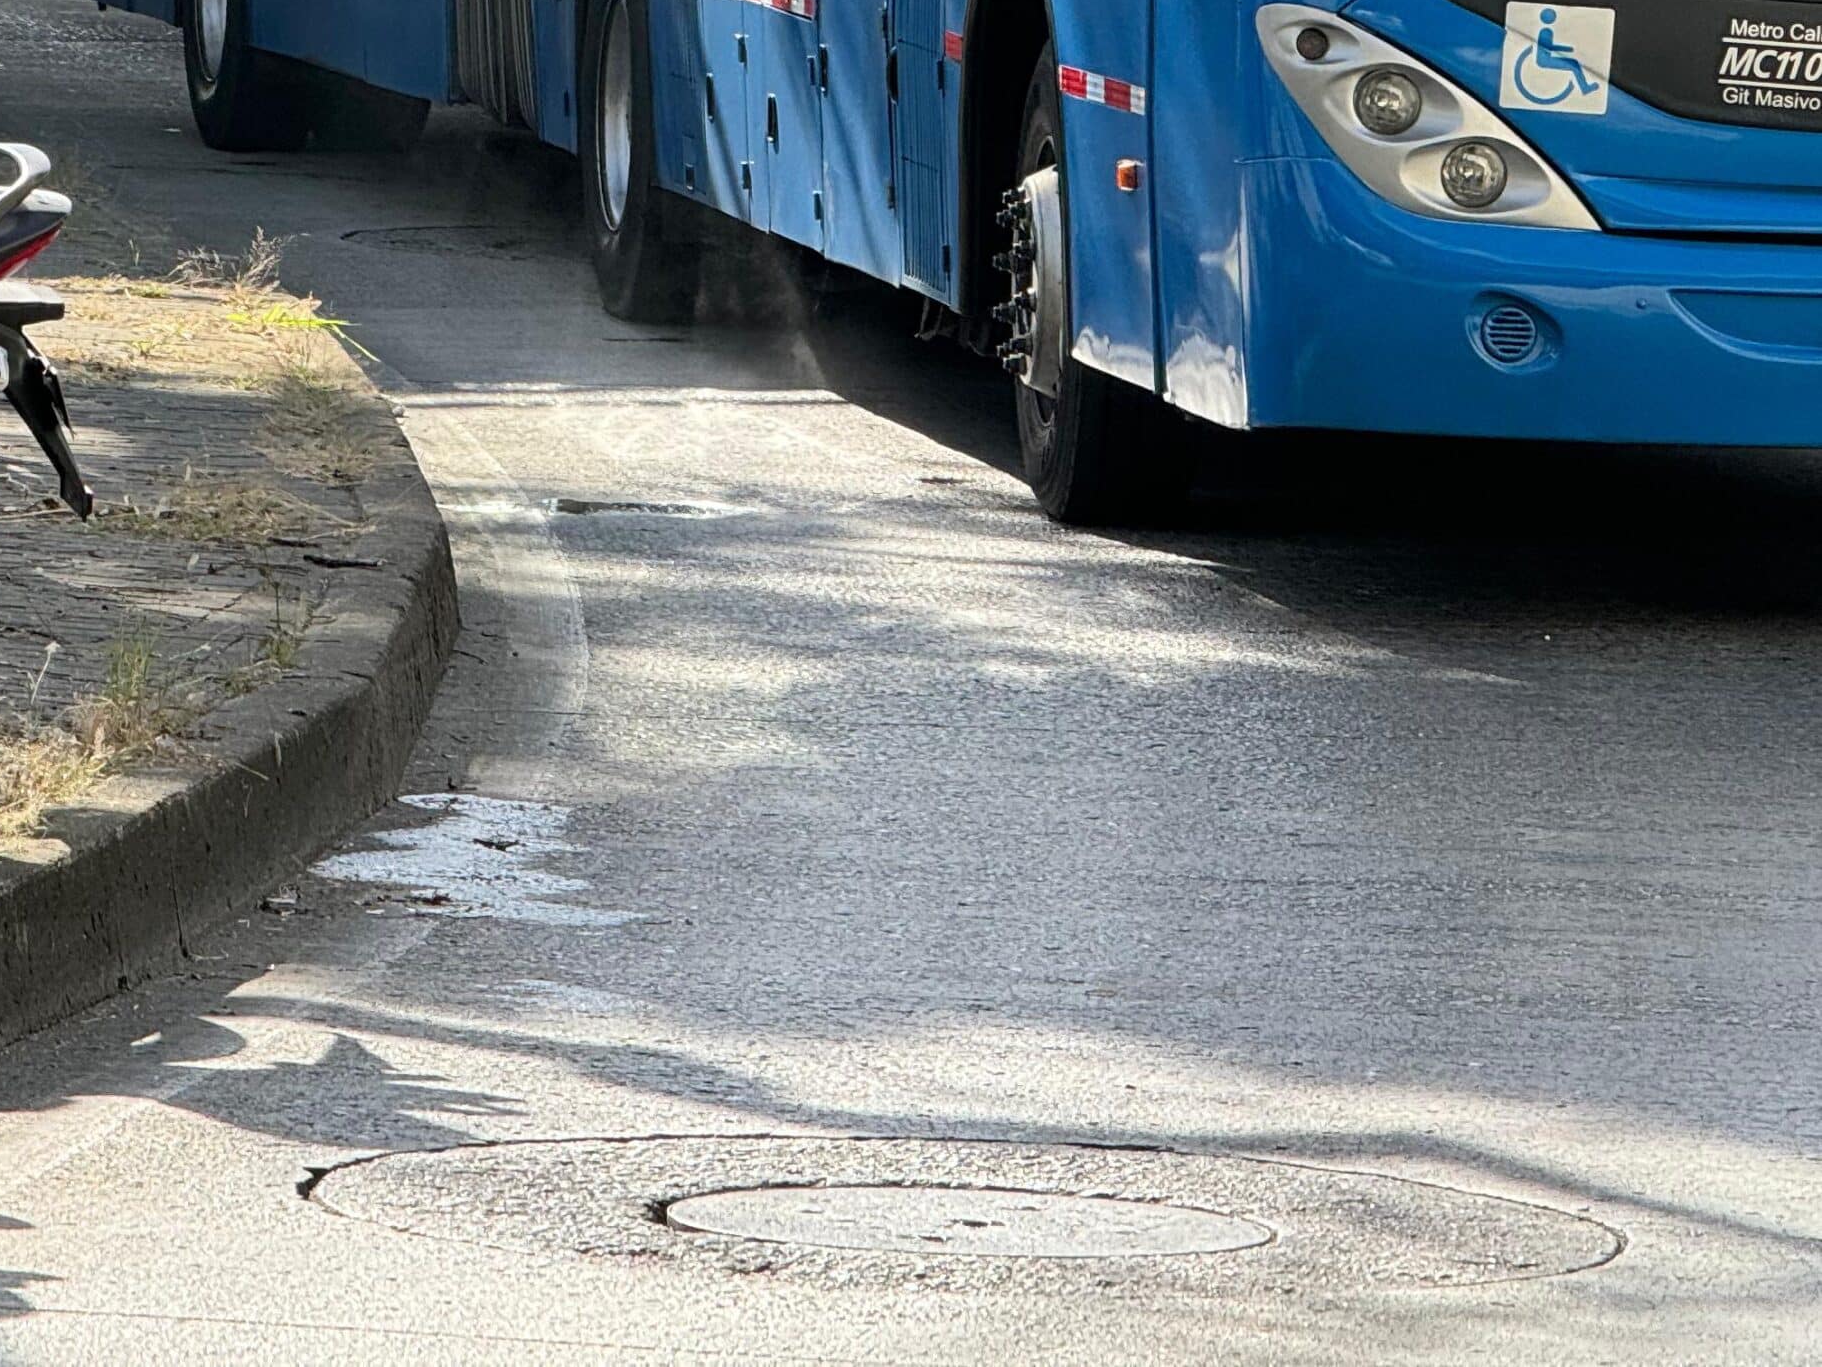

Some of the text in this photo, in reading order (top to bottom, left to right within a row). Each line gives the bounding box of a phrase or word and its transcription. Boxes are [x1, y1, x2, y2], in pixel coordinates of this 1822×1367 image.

[1731, 18, 1822, 43] Metro Cal
[1722, 87, 1821, 111] Git Masivo
